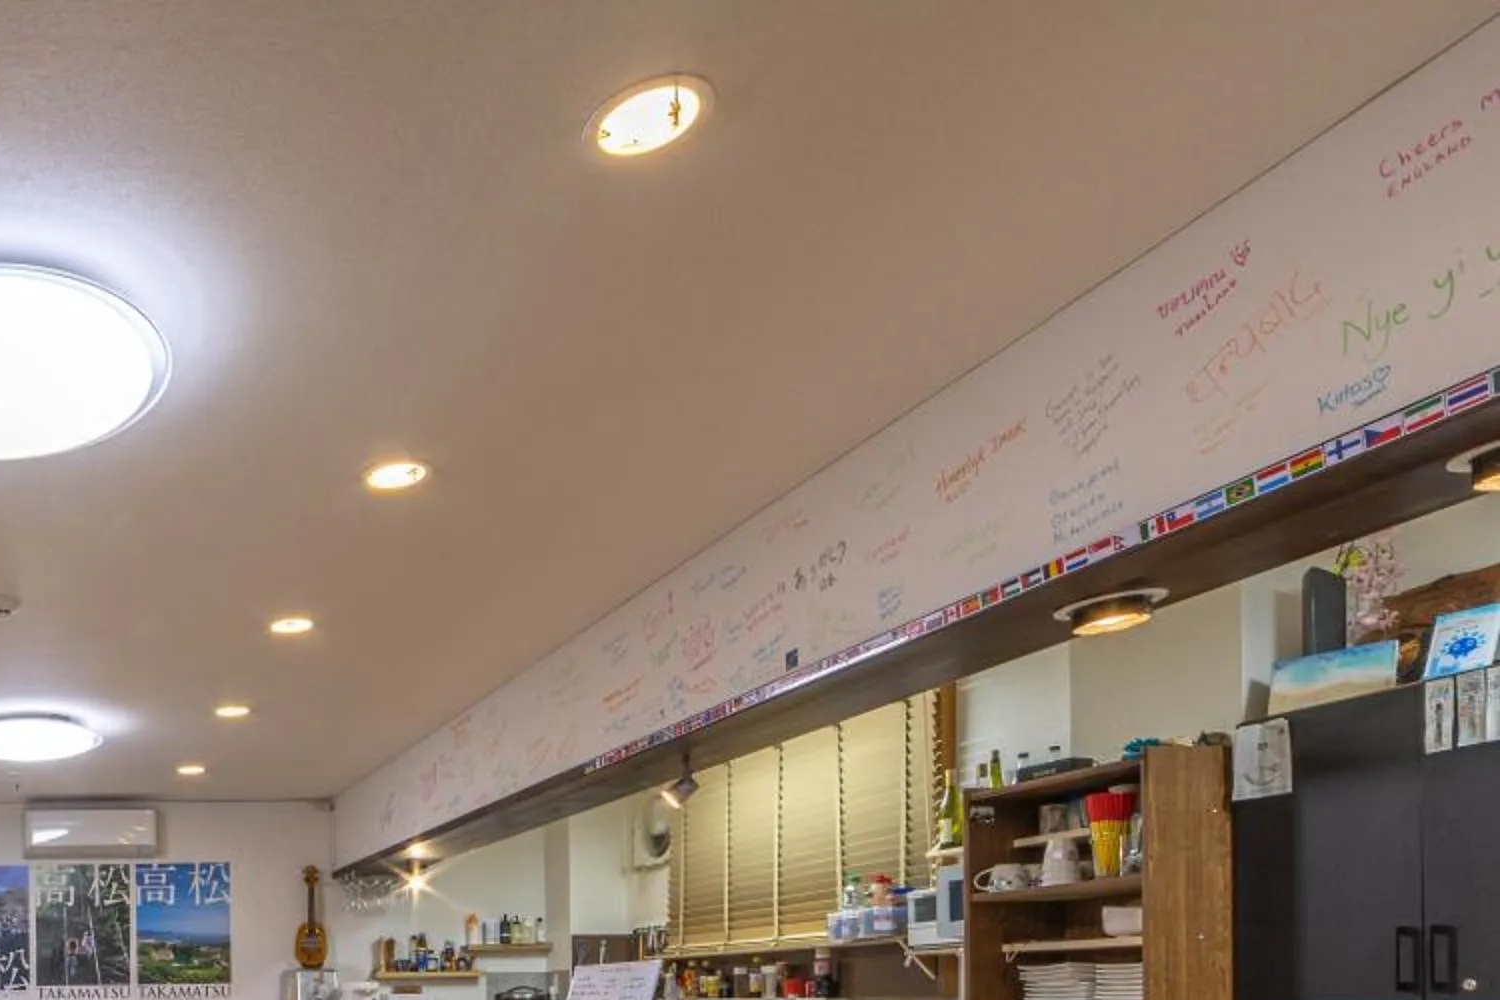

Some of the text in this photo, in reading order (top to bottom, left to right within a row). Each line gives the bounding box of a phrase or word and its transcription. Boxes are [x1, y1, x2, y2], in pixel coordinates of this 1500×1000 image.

[136, 862, 231, 906] 高松
[38, 986, 131, 1000] TAKAMATSU
[139, 984, 231, 999] TAKAMATSU
